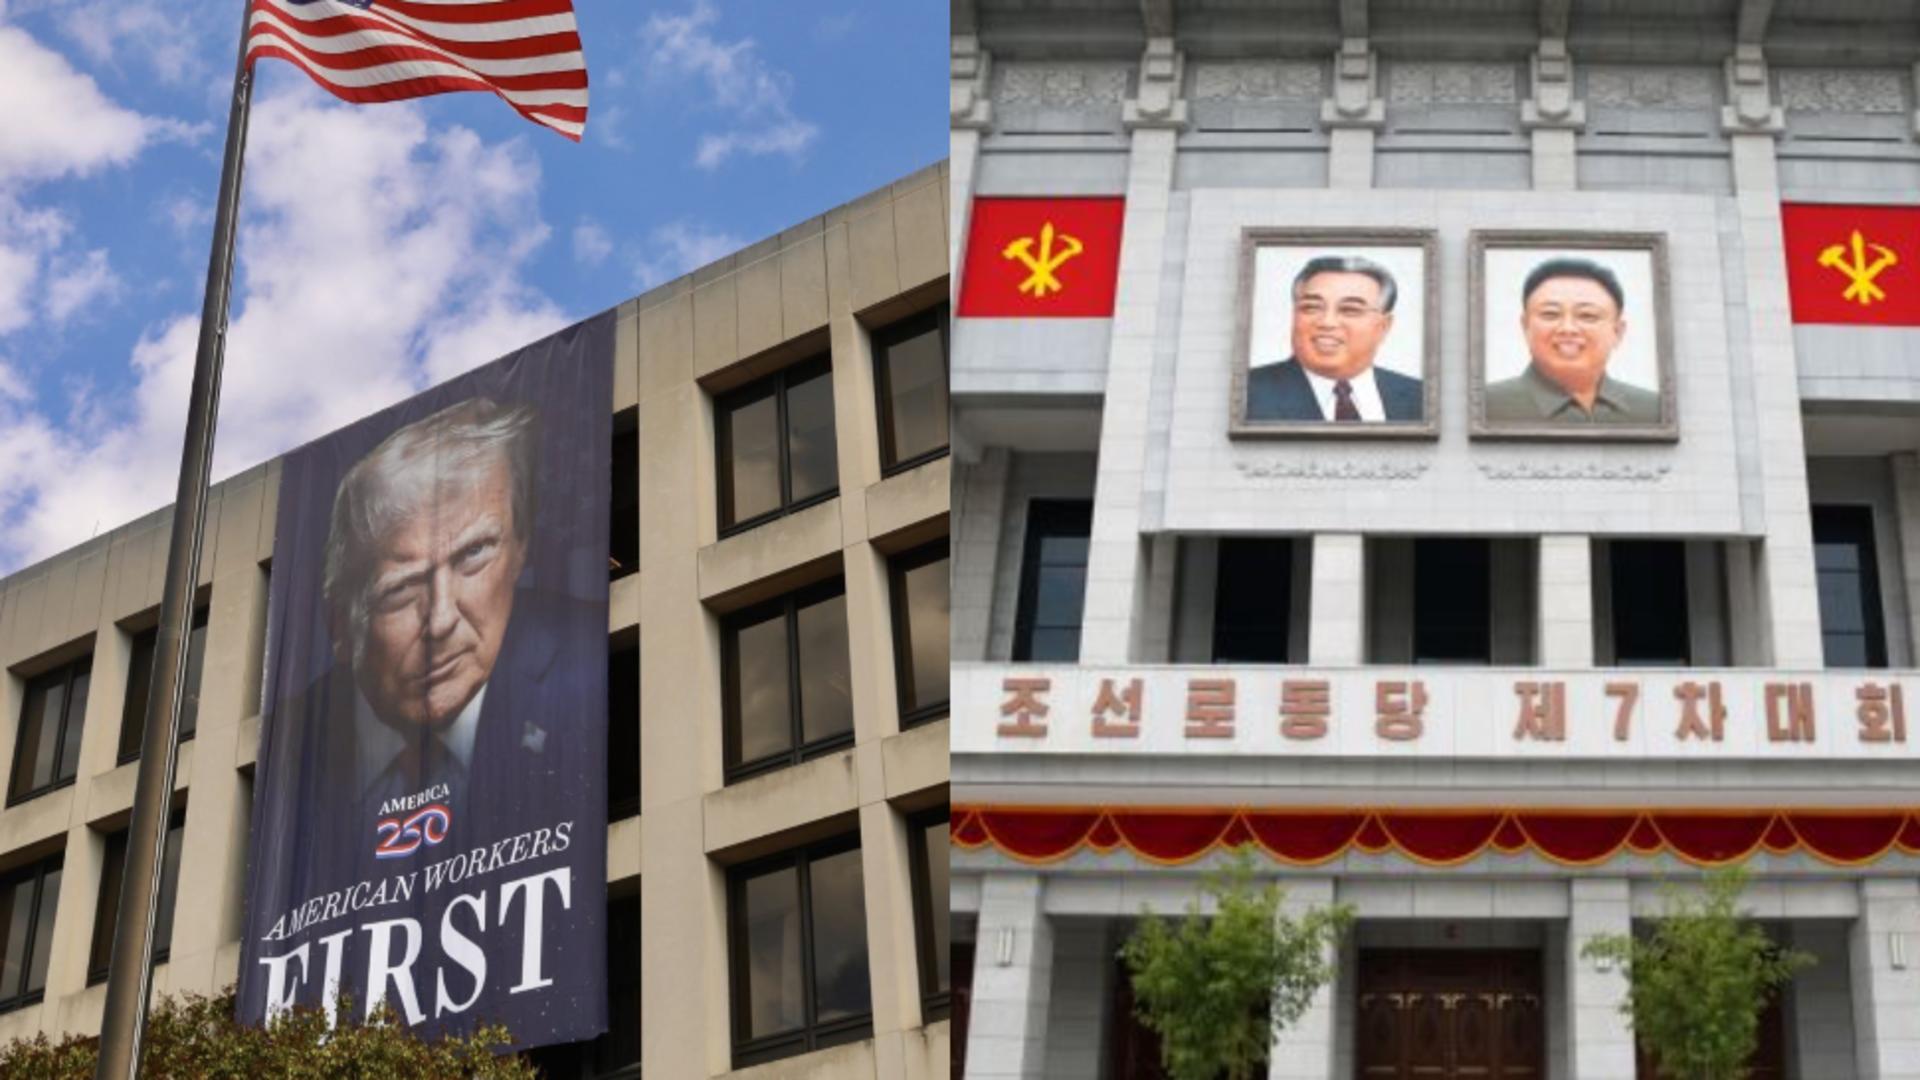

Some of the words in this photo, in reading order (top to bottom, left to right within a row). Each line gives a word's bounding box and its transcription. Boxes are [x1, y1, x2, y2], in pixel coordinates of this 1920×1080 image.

[997, 678, 1428, 741] 조선로동당
[1512, 681, 1906, 743] 제7차대회
[375, 803, 453, 859] 250
[378, 782, 450, 816] AMERICA
[261, 871, 418, 942] AMERICAN
[423, 821, 574, 893] WORKERS
[258, 866, 571, 1046] FIRST
